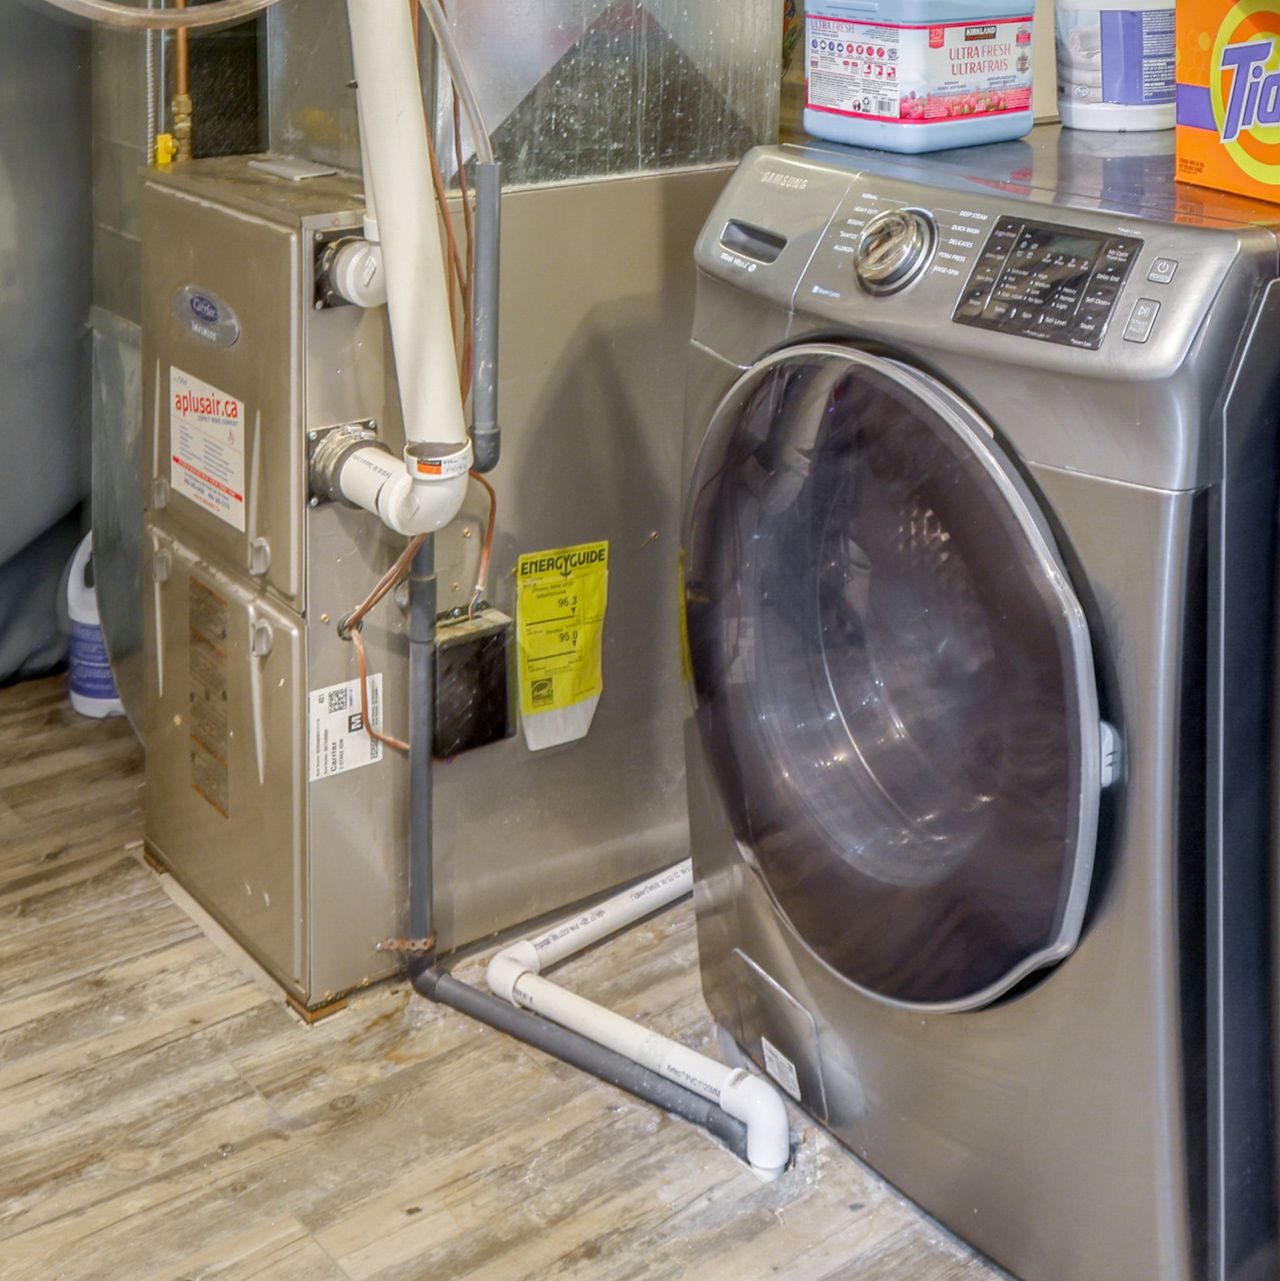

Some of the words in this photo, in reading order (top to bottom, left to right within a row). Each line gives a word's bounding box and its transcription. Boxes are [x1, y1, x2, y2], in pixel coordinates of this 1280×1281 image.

[810, 20, 831, 31] ULTRA
[832, 22, 855, 34] FRESH
[931, 29, 943, 38] 276
[966, 26, 996, 35] KIRKLAND
[948, 48, 980, 61] ULTRA
[982, 43, 1011, 58] FRESH
[951, 59, 1009, 76] ULTRAFRAIS
[761, 171, 808, 190] SAMSUNG
[972, 212, 988, 220] STEAM
[951, 224, 966, 233] QUICK
[948, 238, 973, 248] DELICATES
[1096, 273, 1110, 282] Delay
[1080, 322, 1095, 330] Sound
[175, 389, 239, 419] aplusair.ca
[521, 548, 606, 577] ENERGYGUIDE
[558, 595, 578, 608] 96.3
[558, 630, 578, 643] 95.0
